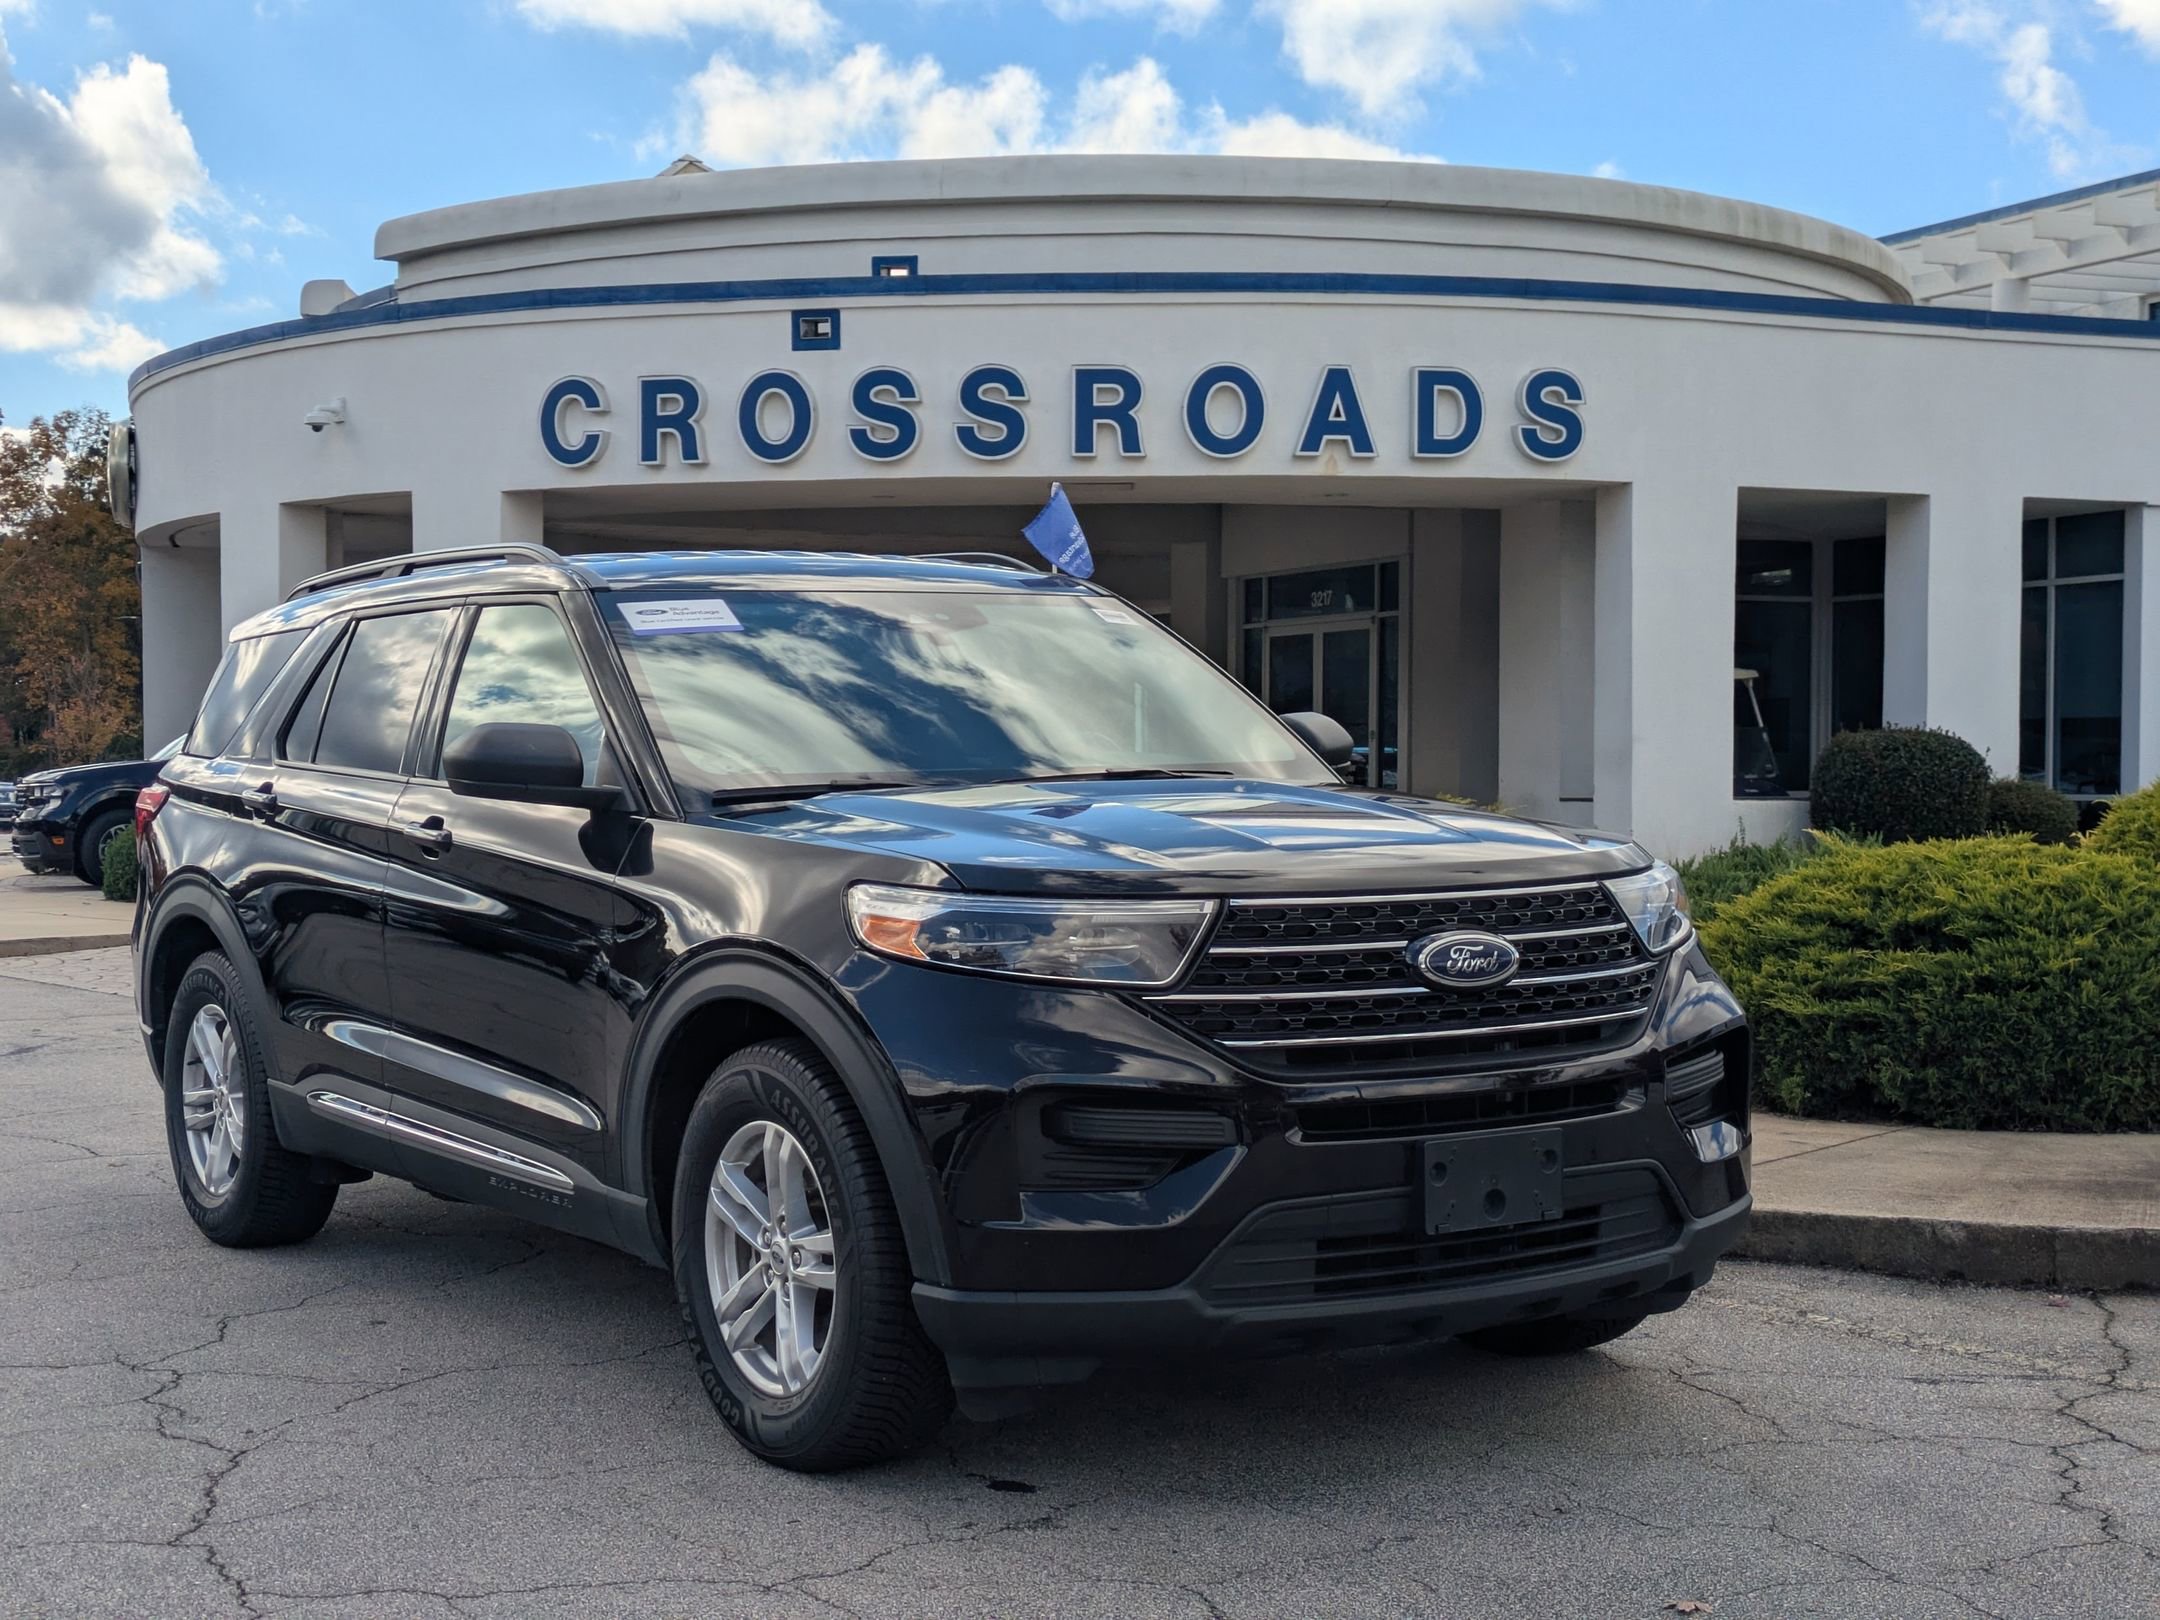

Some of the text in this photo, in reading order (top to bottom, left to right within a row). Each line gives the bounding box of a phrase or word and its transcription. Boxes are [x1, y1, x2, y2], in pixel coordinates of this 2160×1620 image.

[539, 363, 1588, 469] CROSSROADS
[1311, 589, 1333, 608] 3217
[1446, 945, 1499, 975] Ford
[770, 1088, 844, 1234] ASSURANCE
